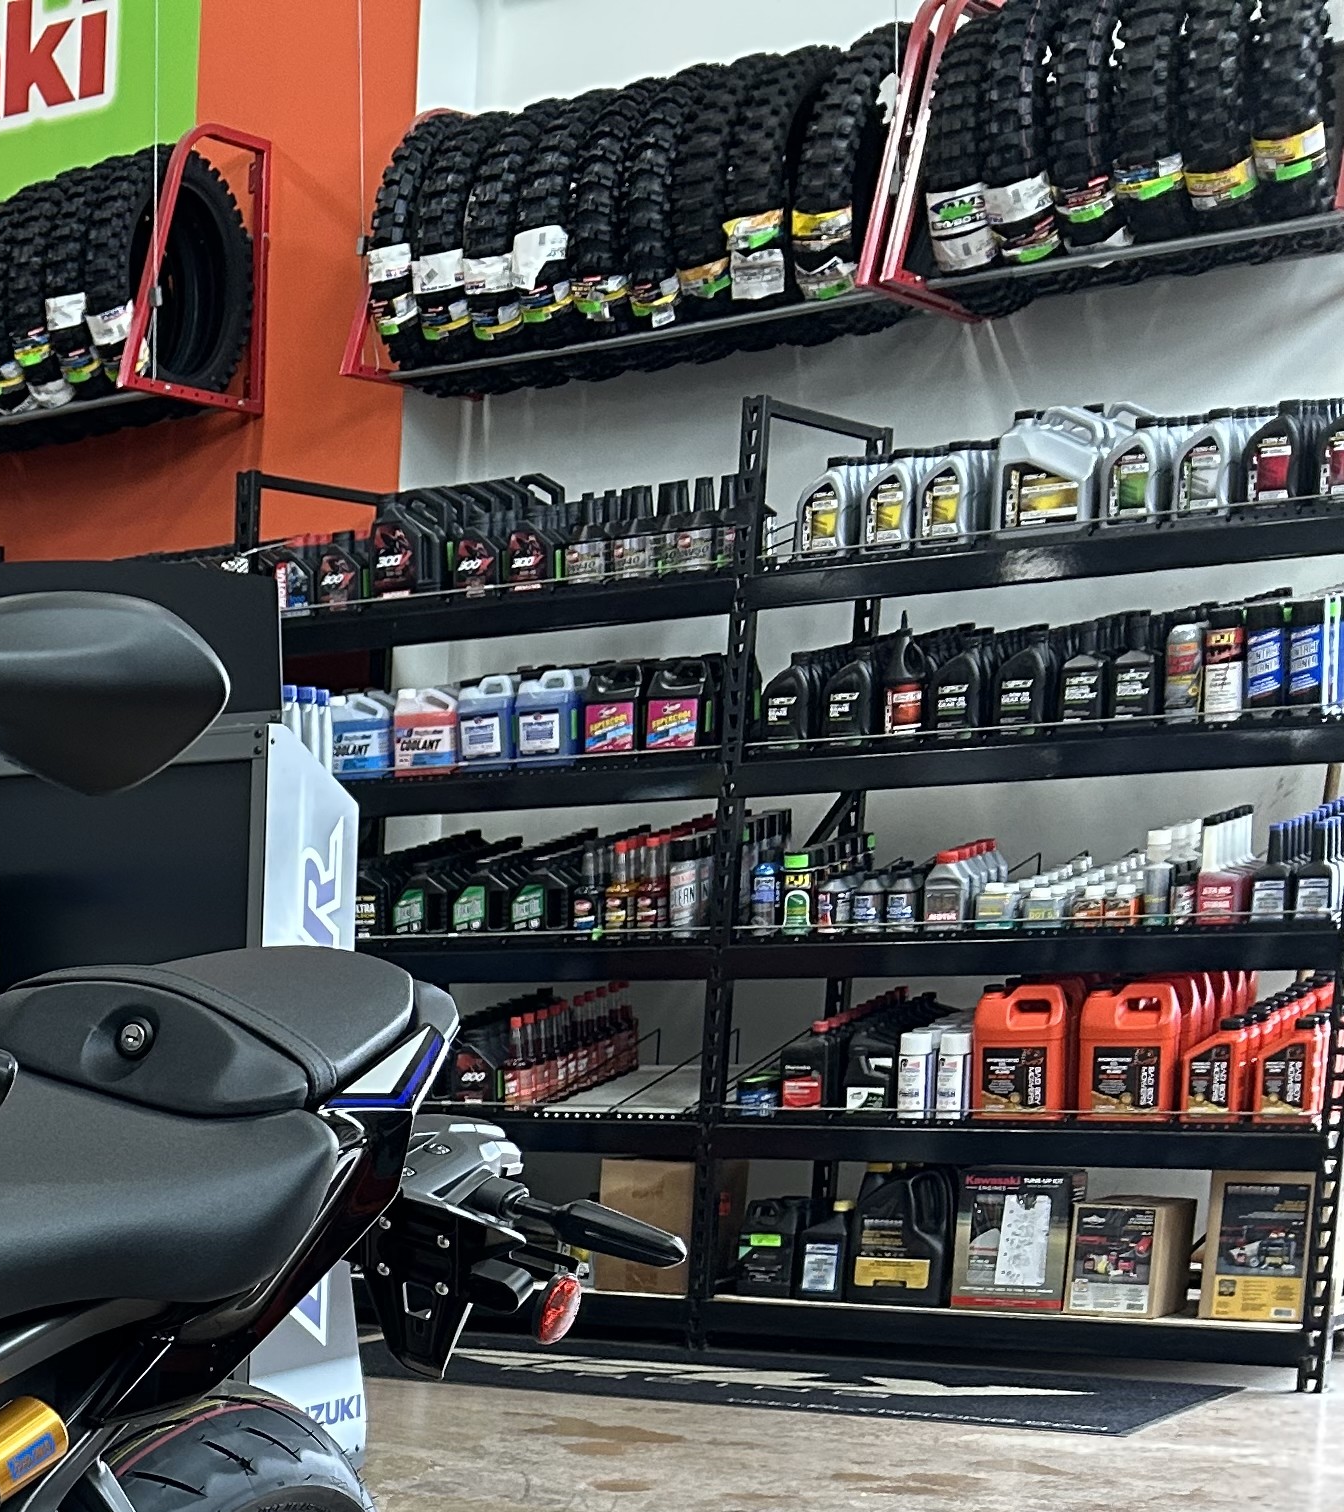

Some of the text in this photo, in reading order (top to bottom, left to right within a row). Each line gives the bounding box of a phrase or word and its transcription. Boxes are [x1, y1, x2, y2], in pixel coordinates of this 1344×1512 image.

[400, 738, 442, 752] COOLANT
[785, 875, 811, 888] PJ1
[355, 904, 375, 914] LTRA
[965, 1174, 1021, 1186] Kawasaki
